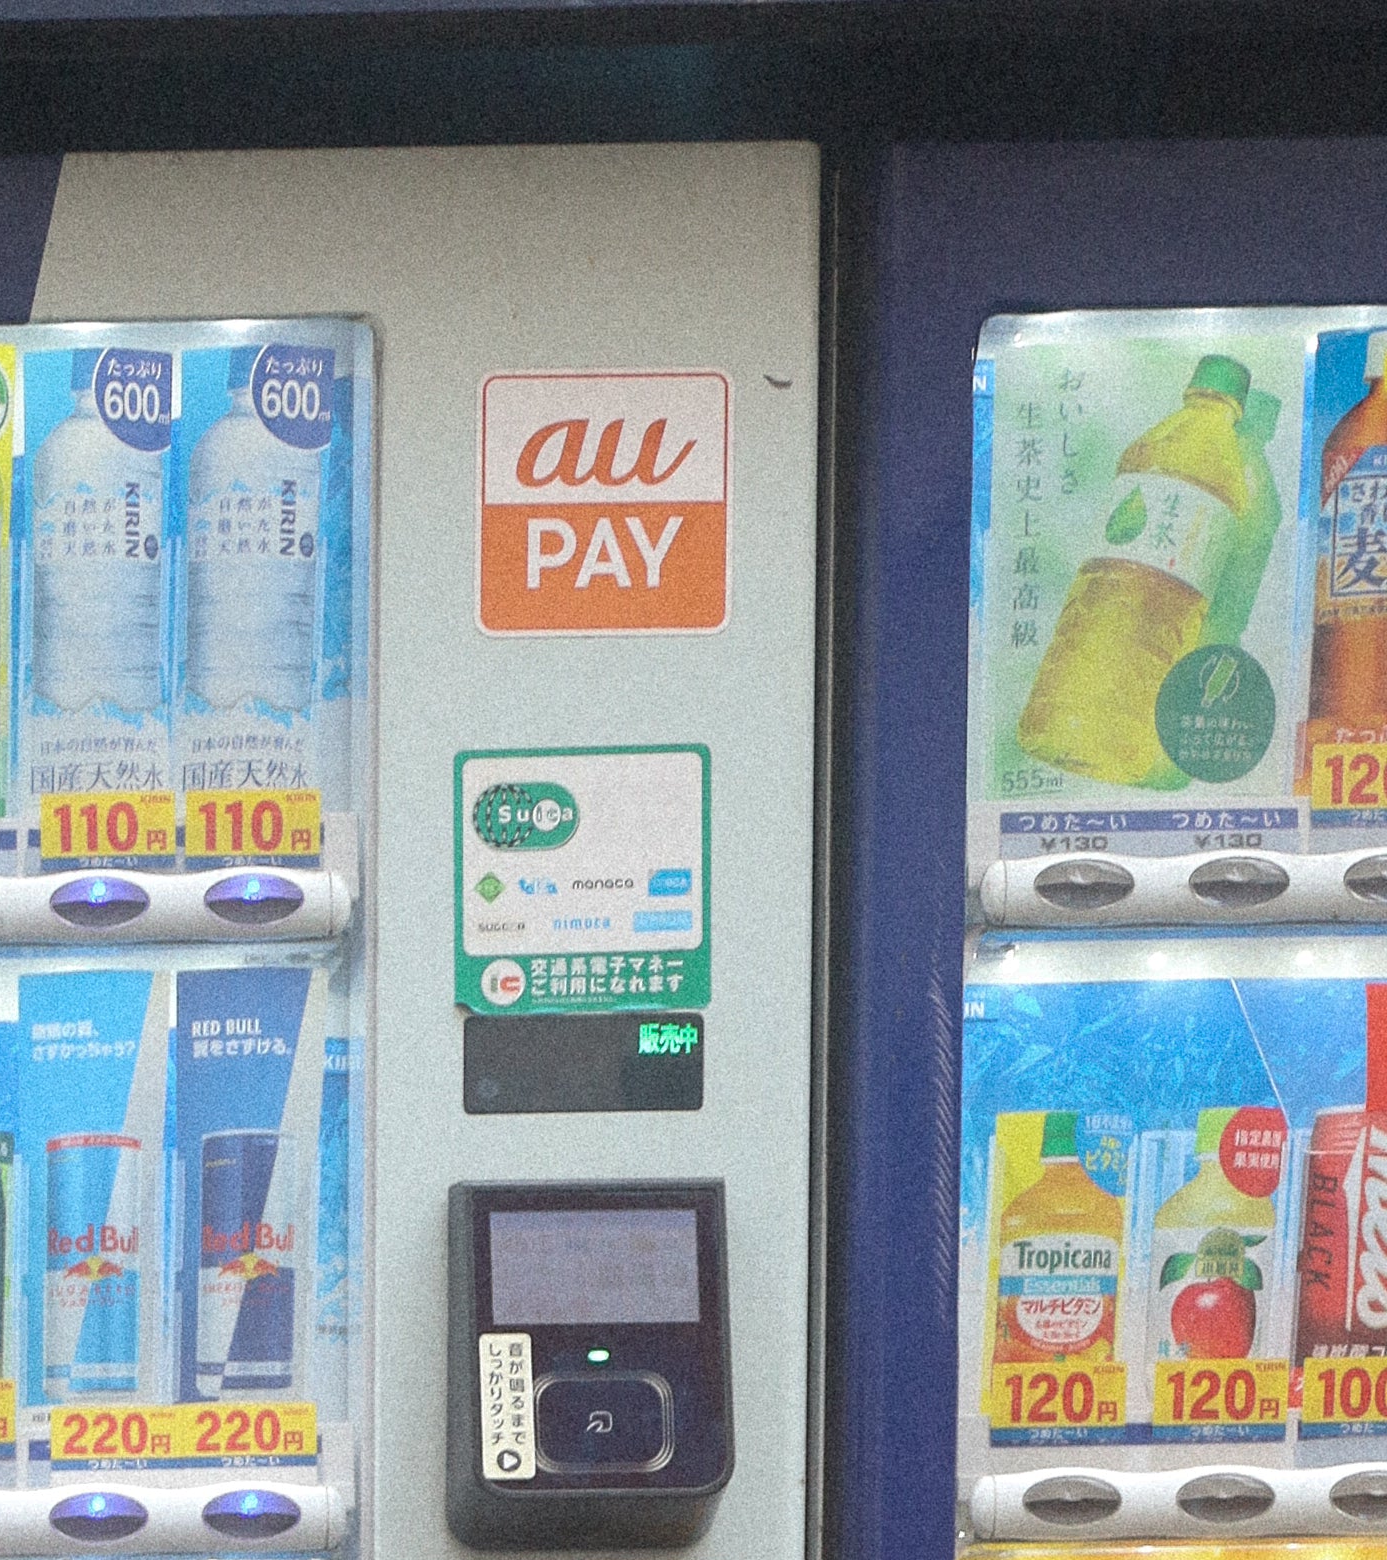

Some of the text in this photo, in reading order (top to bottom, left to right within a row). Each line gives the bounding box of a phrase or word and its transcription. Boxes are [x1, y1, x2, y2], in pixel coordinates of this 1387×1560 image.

[106, 356, 163, 380] たっぷり
[264, 354, 325, 377] たっぷり
[1057, 368, 1085, 497] おいしさ
[515, 416, 698, 489] au
[124, 480, 142, 560] KIRIN
[1010, 400, 1047, 651] 生茶史上最高級
[525, 515, 685, 591] PAY
[30, 762, 164, 793] 国産天然水
[181, 760, 309, 791] 国産天然水
[51, 800, 168, 855] 110円
[196, 798, 313, 853] 110円
[497, 803, 574, 827] Suica
[1039, 835, 1109, 853] ¥130
[1194, 832, 1263, 849] ¥130
[571, 877, 635, 891] manaca
[530, 974, 685, 995] ご利用になれます
[191, 1017, 263, 1038] RED BULL
[637, 1022, 699, 1056] 販売中
[1304, 1170, 1339, 1294] BLACK
[1011, 1240, 1113, 1274] Tropicana
[1019, 1298, 1104, 1317] マルチビタミン
[1003, 1370, 1120, 1424] 120円
[1165, 1367, 1282, 1422] 120円
[61, 1410, 172, 1456] 220円
[194, 1408, 305, 1454] 220円
